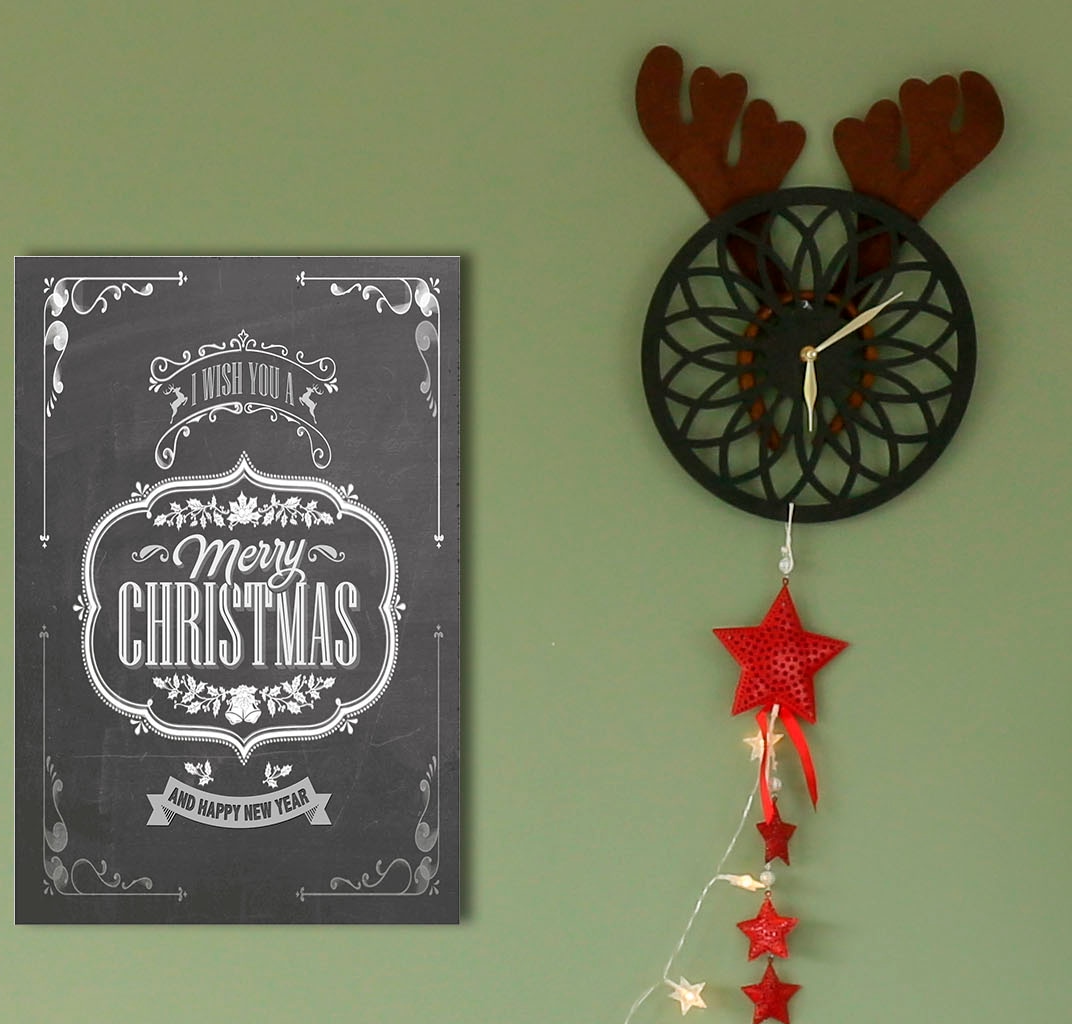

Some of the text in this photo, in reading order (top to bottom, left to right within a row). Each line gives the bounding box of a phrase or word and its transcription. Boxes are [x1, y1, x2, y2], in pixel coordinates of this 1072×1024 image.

[191, 361, 295, 407] I WISH YOU A
[172, 533, 307, 593] Merry
[118, 581, 361, 670] CHRISTMAS
[167, 787, 310, 821] AND HAPPY NEW YEAR
